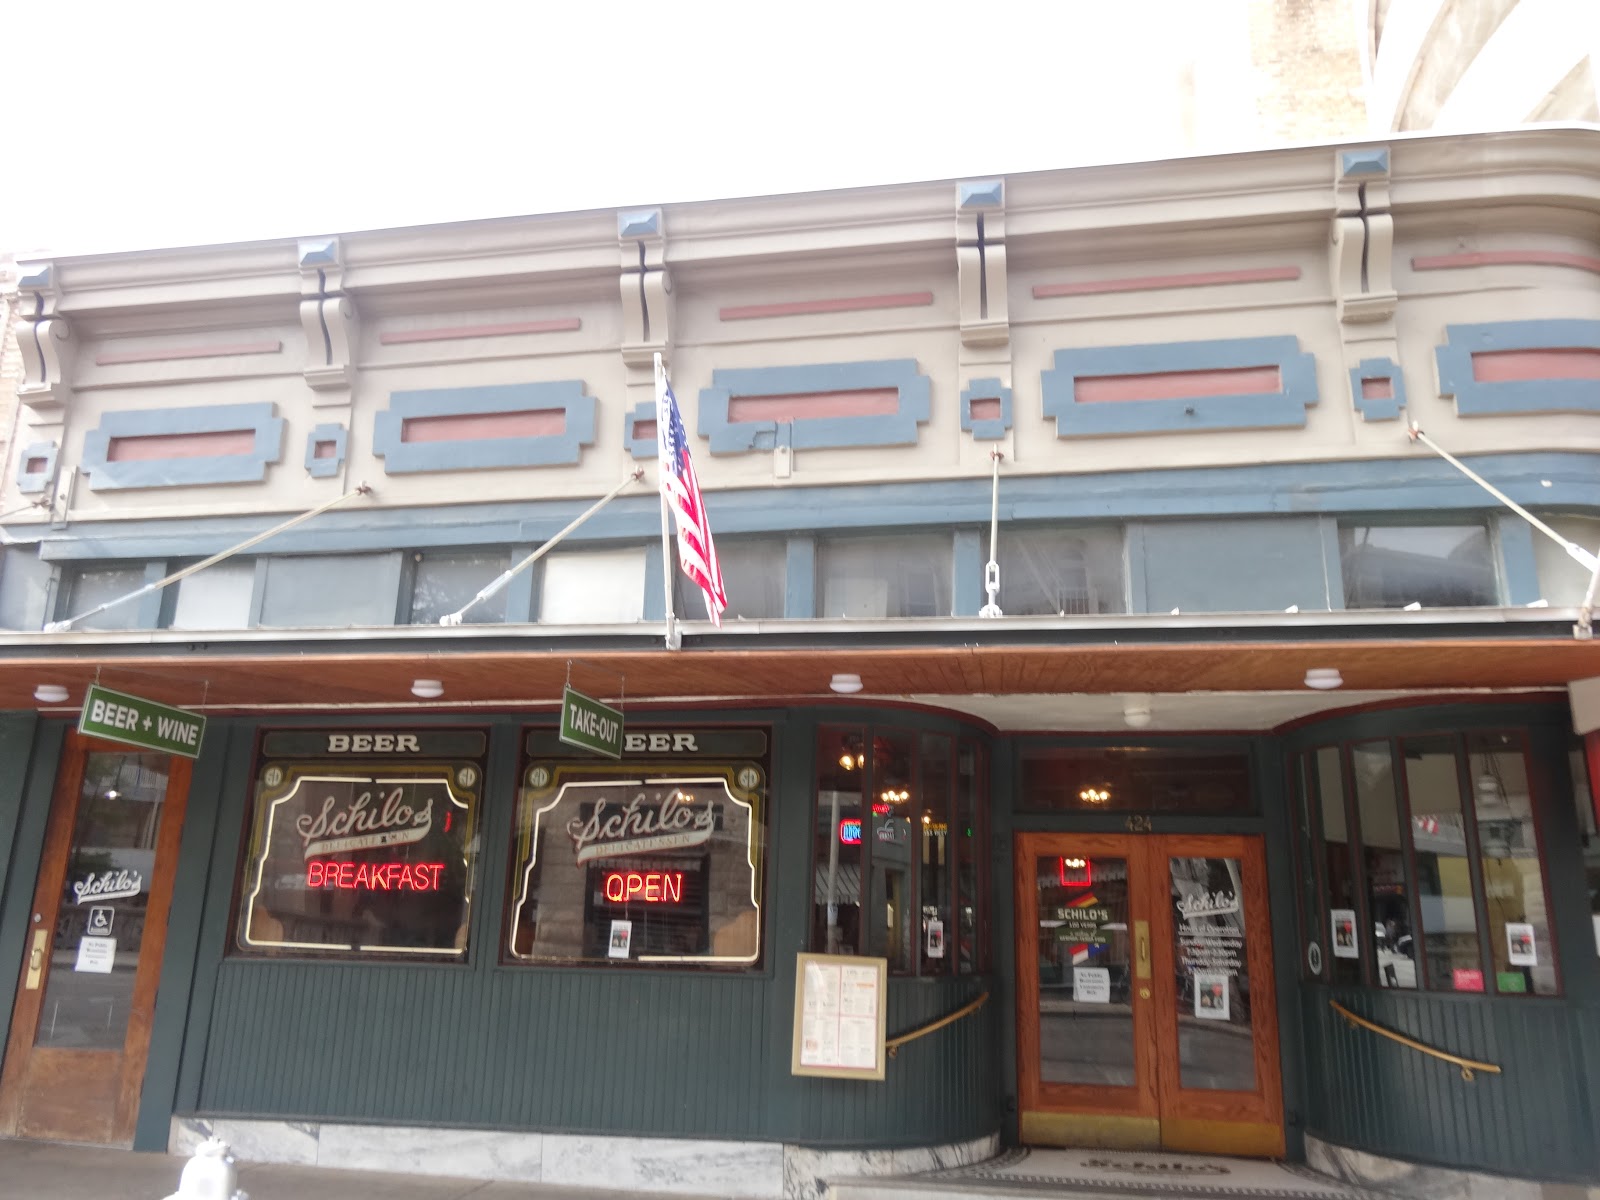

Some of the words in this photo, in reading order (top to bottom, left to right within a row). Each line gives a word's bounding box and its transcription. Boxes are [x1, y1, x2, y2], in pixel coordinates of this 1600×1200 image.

[91, 699, 139, 731] BEER
[157, 716, 199, 745] WINE
[570, 704, 619, 745] TAKE-OUT
[328, 734, 420, 752] BEER
[624, 733, 699, 752] EER
[307, 861, 445, 890] BREAKFAST
[605, 873, 683, 902] OPEN
[1057, 908, 1108, 920] SCHILO'S
